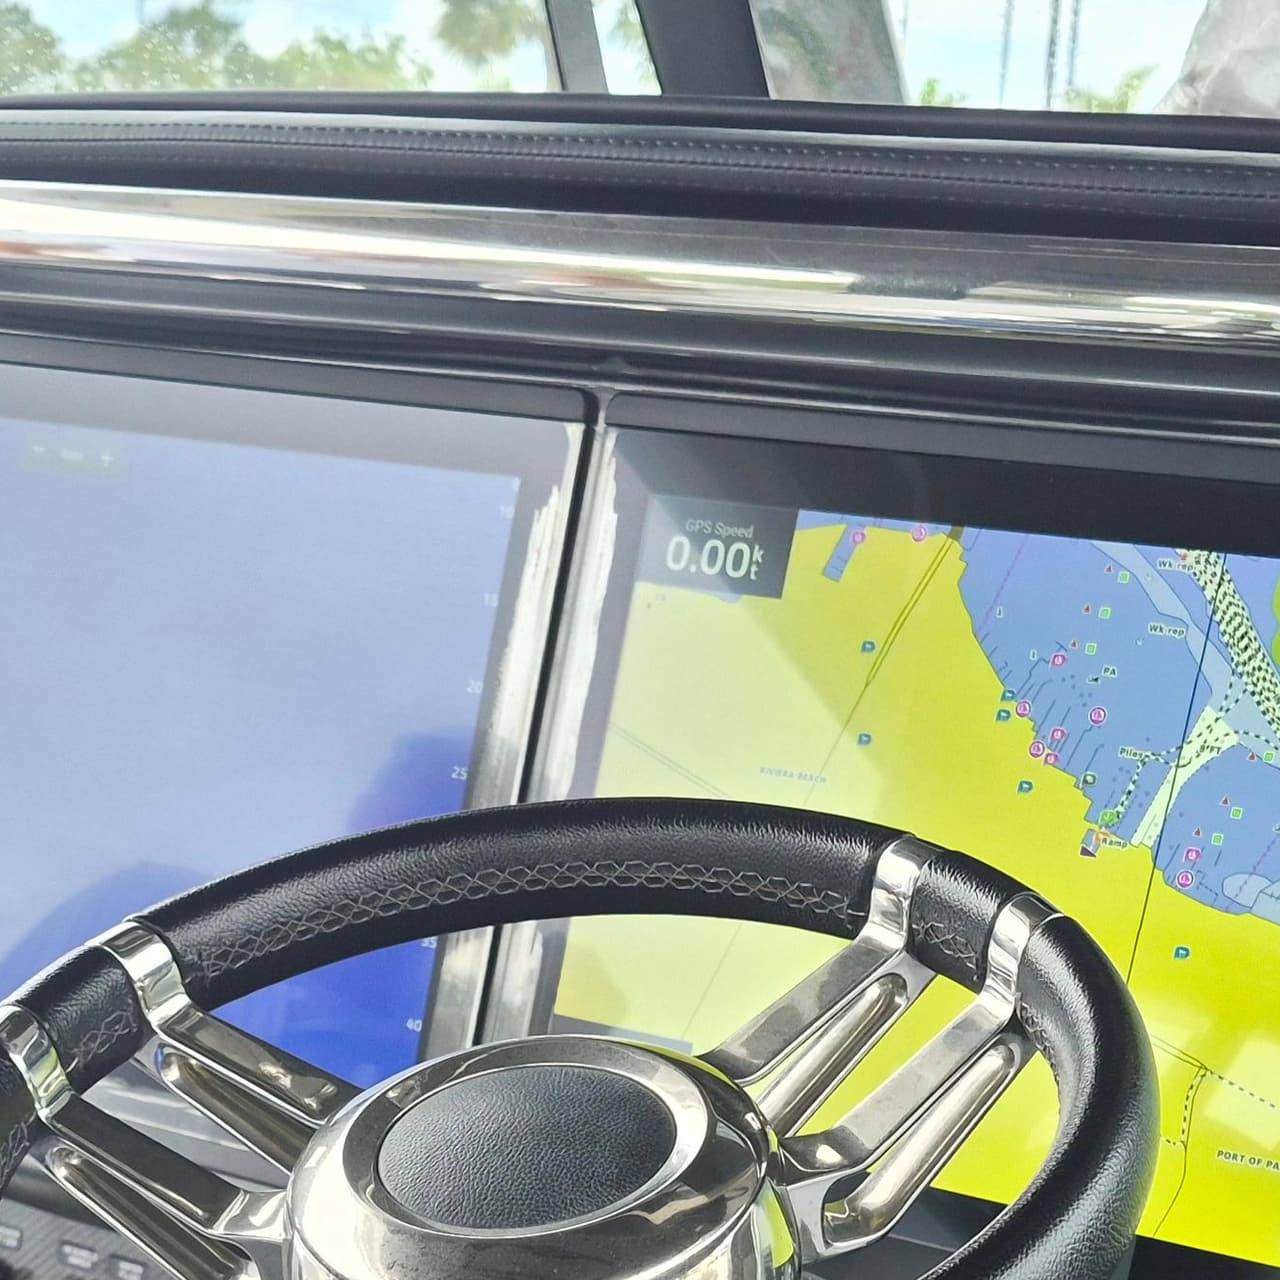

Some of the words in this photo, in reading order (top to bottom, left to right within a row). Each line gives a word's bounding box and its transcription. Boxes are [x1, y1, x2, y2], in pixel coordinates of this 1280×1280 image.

[686, 519, 713, 535] GPS
[714, 522, 755, 539] Speed
[666, 535, 751, 578] 0.00
[1149, 624, 1164, 634] Wk
[1168, 627, 1185, 637] rep
[1103, 667, 1117, 676] PA
[451, 765, 468, 780] 25
[1217, 1150, 1245, 1163] PORT
[1248, 1157, 1263, 1166] OF
